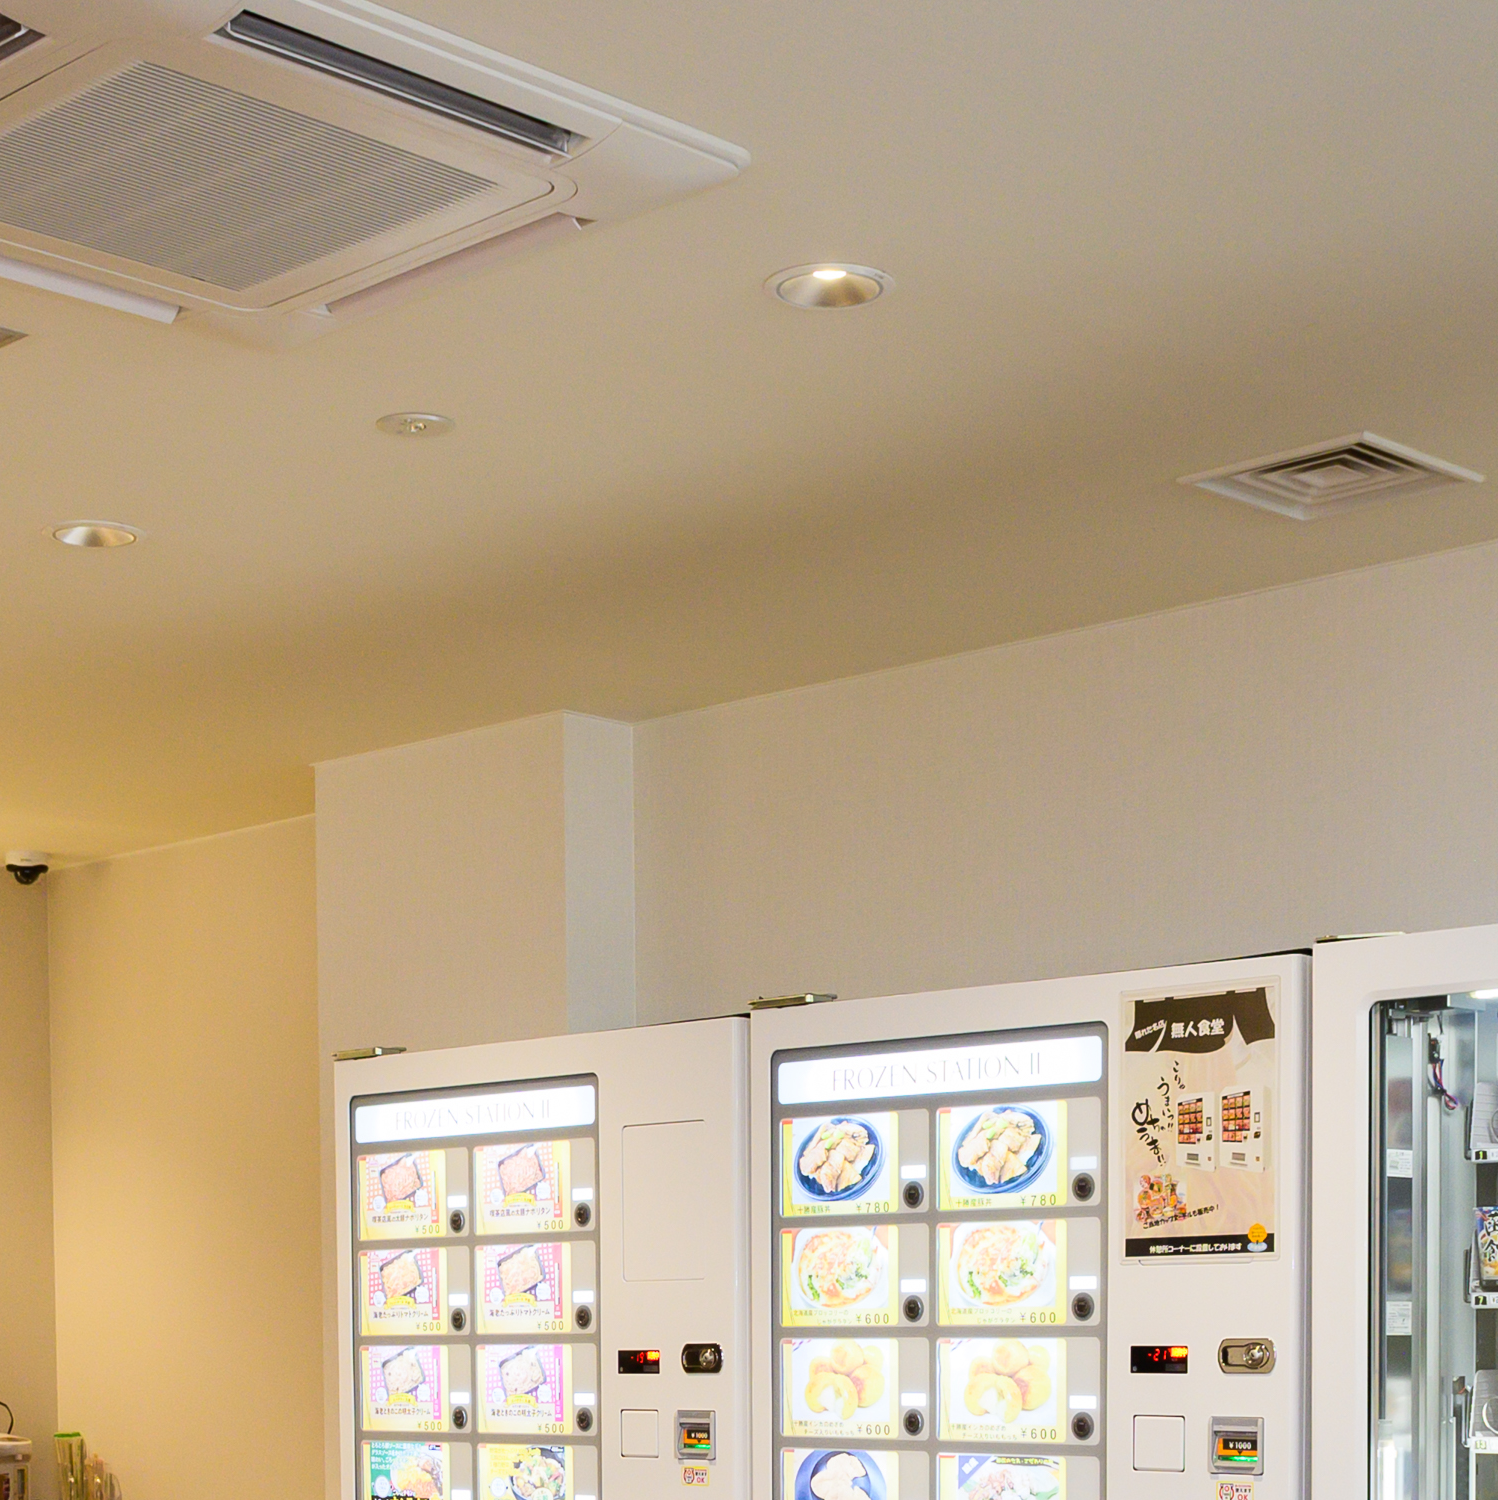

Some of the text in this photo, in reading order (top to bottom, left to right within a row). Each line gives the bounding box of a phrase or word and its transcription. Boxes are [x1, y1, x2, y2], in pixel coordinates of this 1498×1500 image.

[1171, 1018, 1224, 1039] 無人食堂
[833, 1052, 1040, 1091] FROZEN STATION II
[396, 1098, 550, 1131] FROZEN STATION II
[1478, 1151, 1484, 1159] 1
[955, 1197, 992, 1208] 十勝産豚丼
[1020, 1194, 1057, 1207] ¥780
[796, 1204, 831, 1214] 十勝産豚丼
[855, 1201, 890, 1213] ¥780
[415, 1224, 440, 1234] ¥500
[537, 1219, 564, 1230] ¥500
[1478, 1295, 1484, 1304] 7
[793, 1307, 849, 1316] 北海道産ブロッコリーの
[950, 1307, 1012, 1316] 北海道産ブロッコリーの
[855, 1313, 889, 1325] ¥600
[1019, 1311, 1056, 1324] ¥600
[416, 1322, 441, 1331] ¥500
[537, 1320, 564, 1331] ¥500
[417, 1421, 442, 1431] ¥500
[538, 1423, 564, 1434] ¥500
[793, 1420, 844, 1428] 十勝産インカのめざめ
[856, 1423, 890, 1436] ¥600
[951, 1423, 1007, 1432] 十勝産インカのめざめ
[1020, 1427, 1057, 1440] ¥600
[1229, 1441, 1252, 1450] ¥1000
[1475, 1440, 1486, 1449] 13
